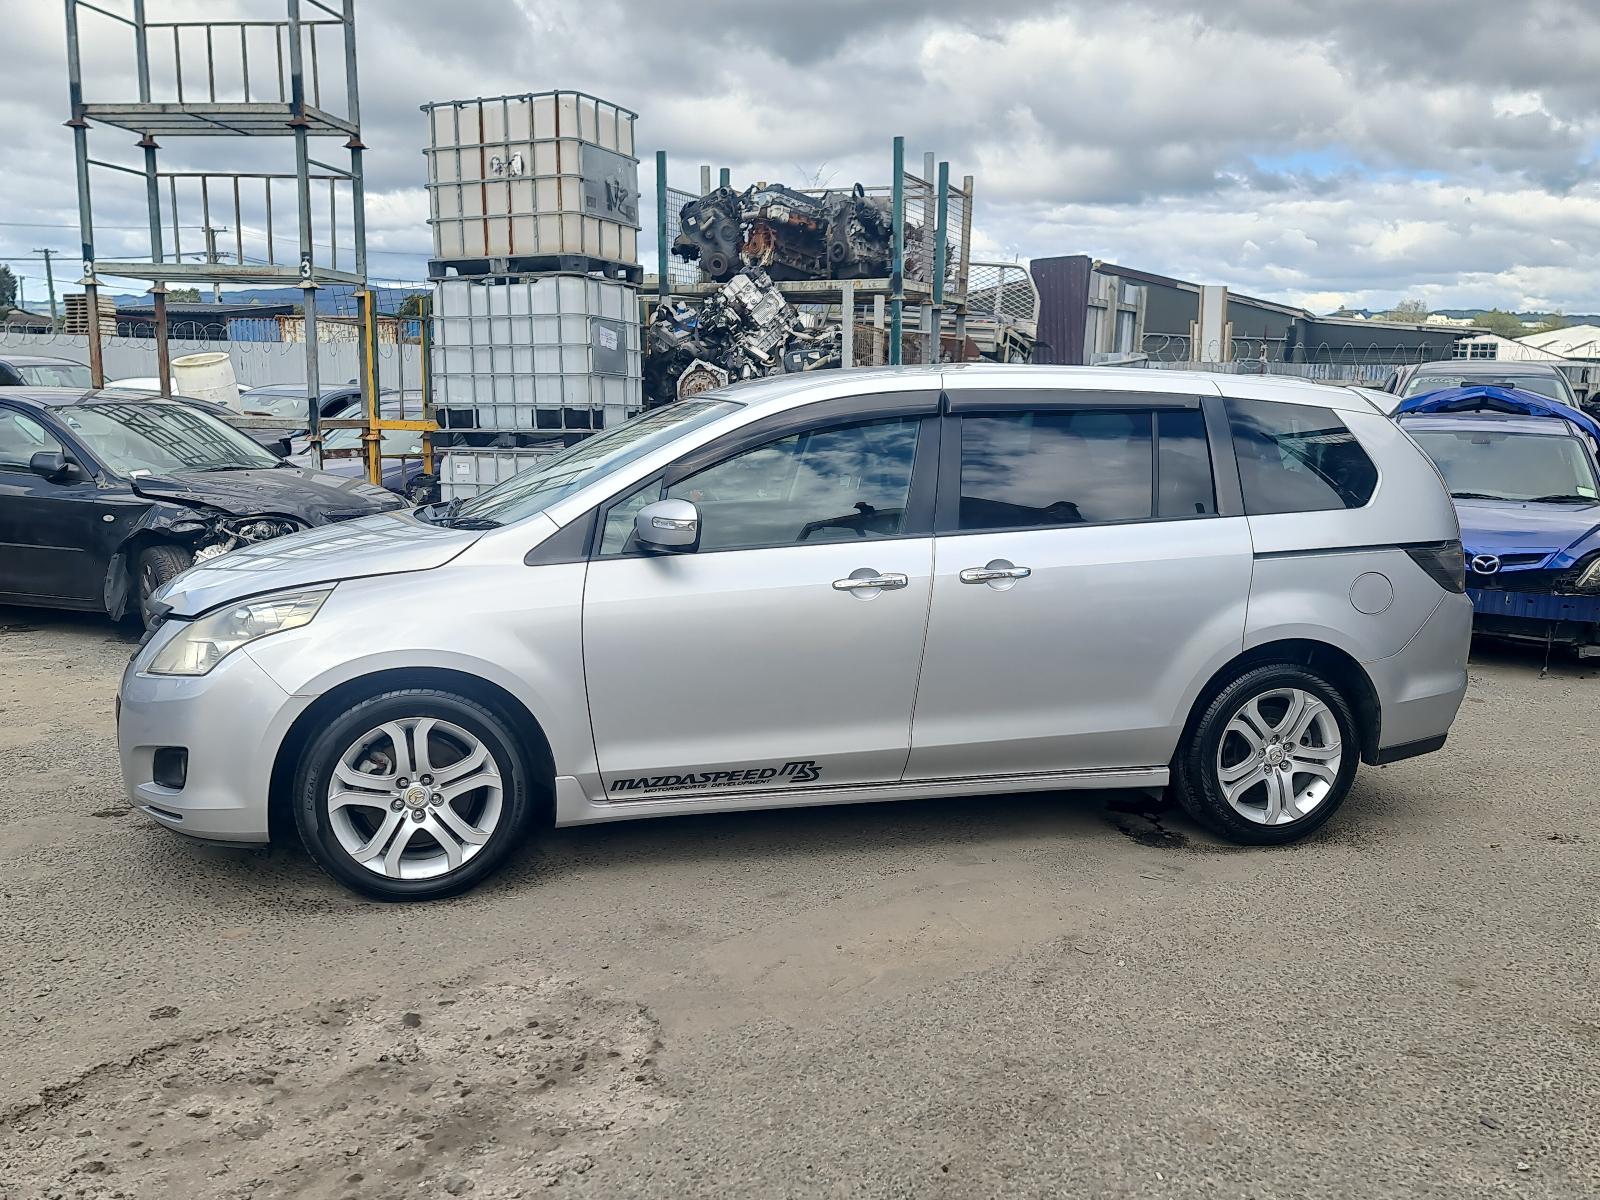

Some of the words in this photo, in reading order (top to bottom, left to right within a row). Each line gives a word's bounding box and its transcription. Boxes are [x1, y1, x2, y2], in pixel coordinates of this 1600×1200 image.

[83, 260, 93, 277] 3
[301, 261, 310, 278] 3
[610, 767, 777, 792] MAZDASPEED
[643, 783, 708, 794] MOTORSPORTS
[711, 778, 772, 788] DEVELOPMENT
